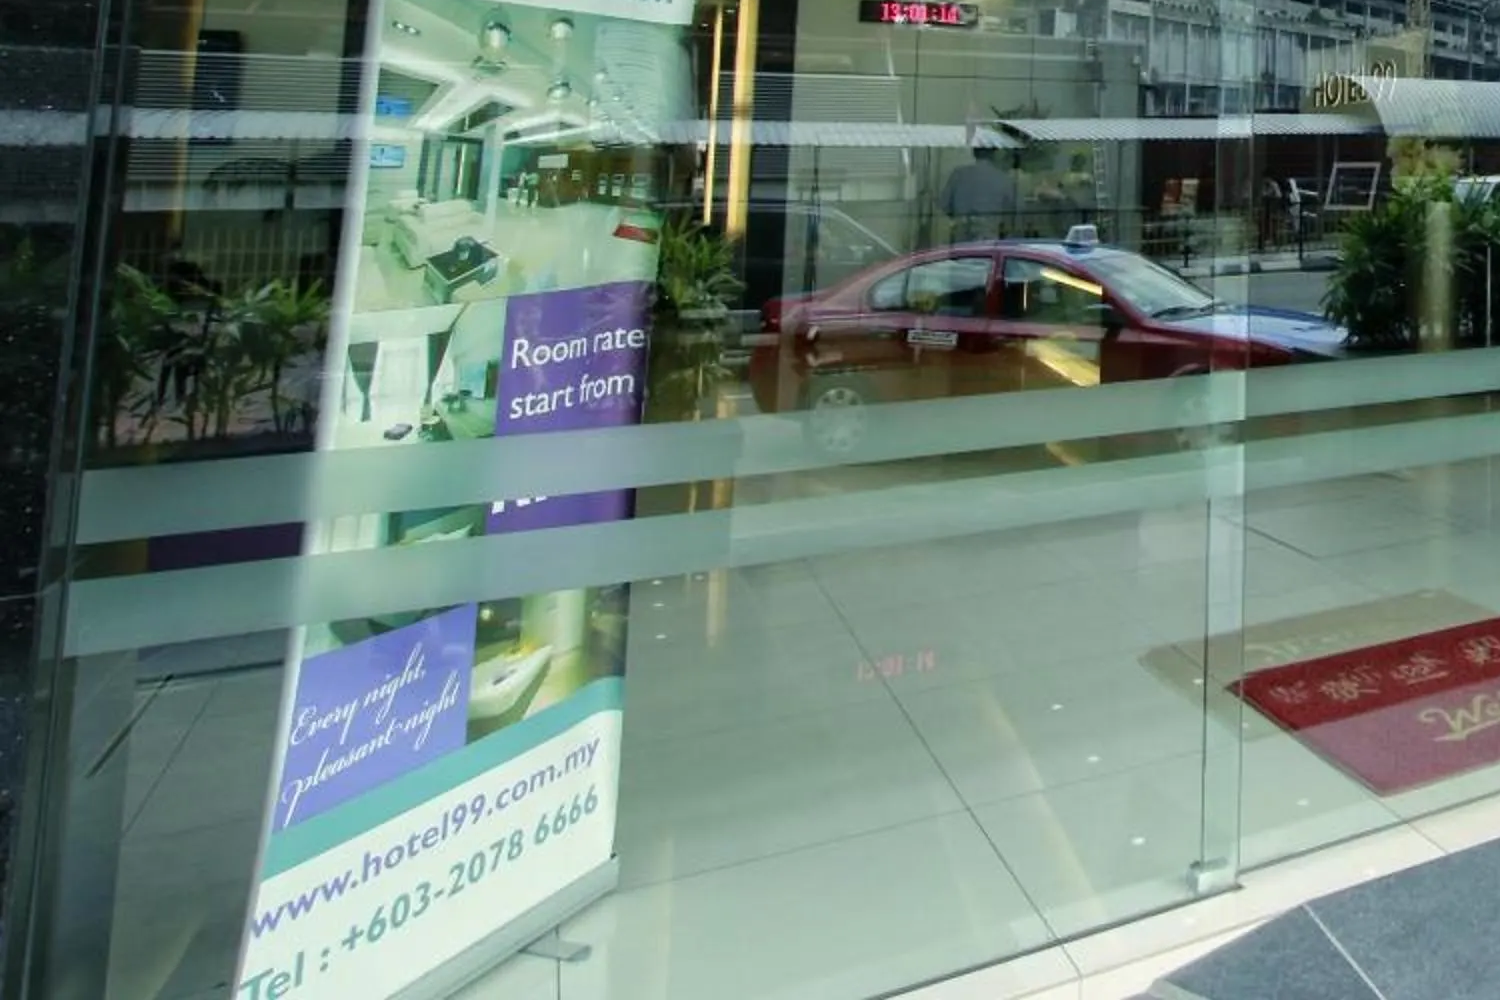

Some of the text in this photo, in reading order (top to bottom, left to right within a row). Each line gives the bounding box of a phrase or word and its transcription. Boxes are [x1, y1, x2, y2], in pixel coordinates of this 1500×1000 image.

[511, 327, 645, 369] Room rate
[509, 373, 635, 420] start from
[291, 699, 358, 745] Every
[251, 738, 600, 939] www.hotel99.com.my
[240, 950, 304, 1000] Tel
[341, 827, 523, 952] +603-2078
[533, 784, 598, 848] 6666
